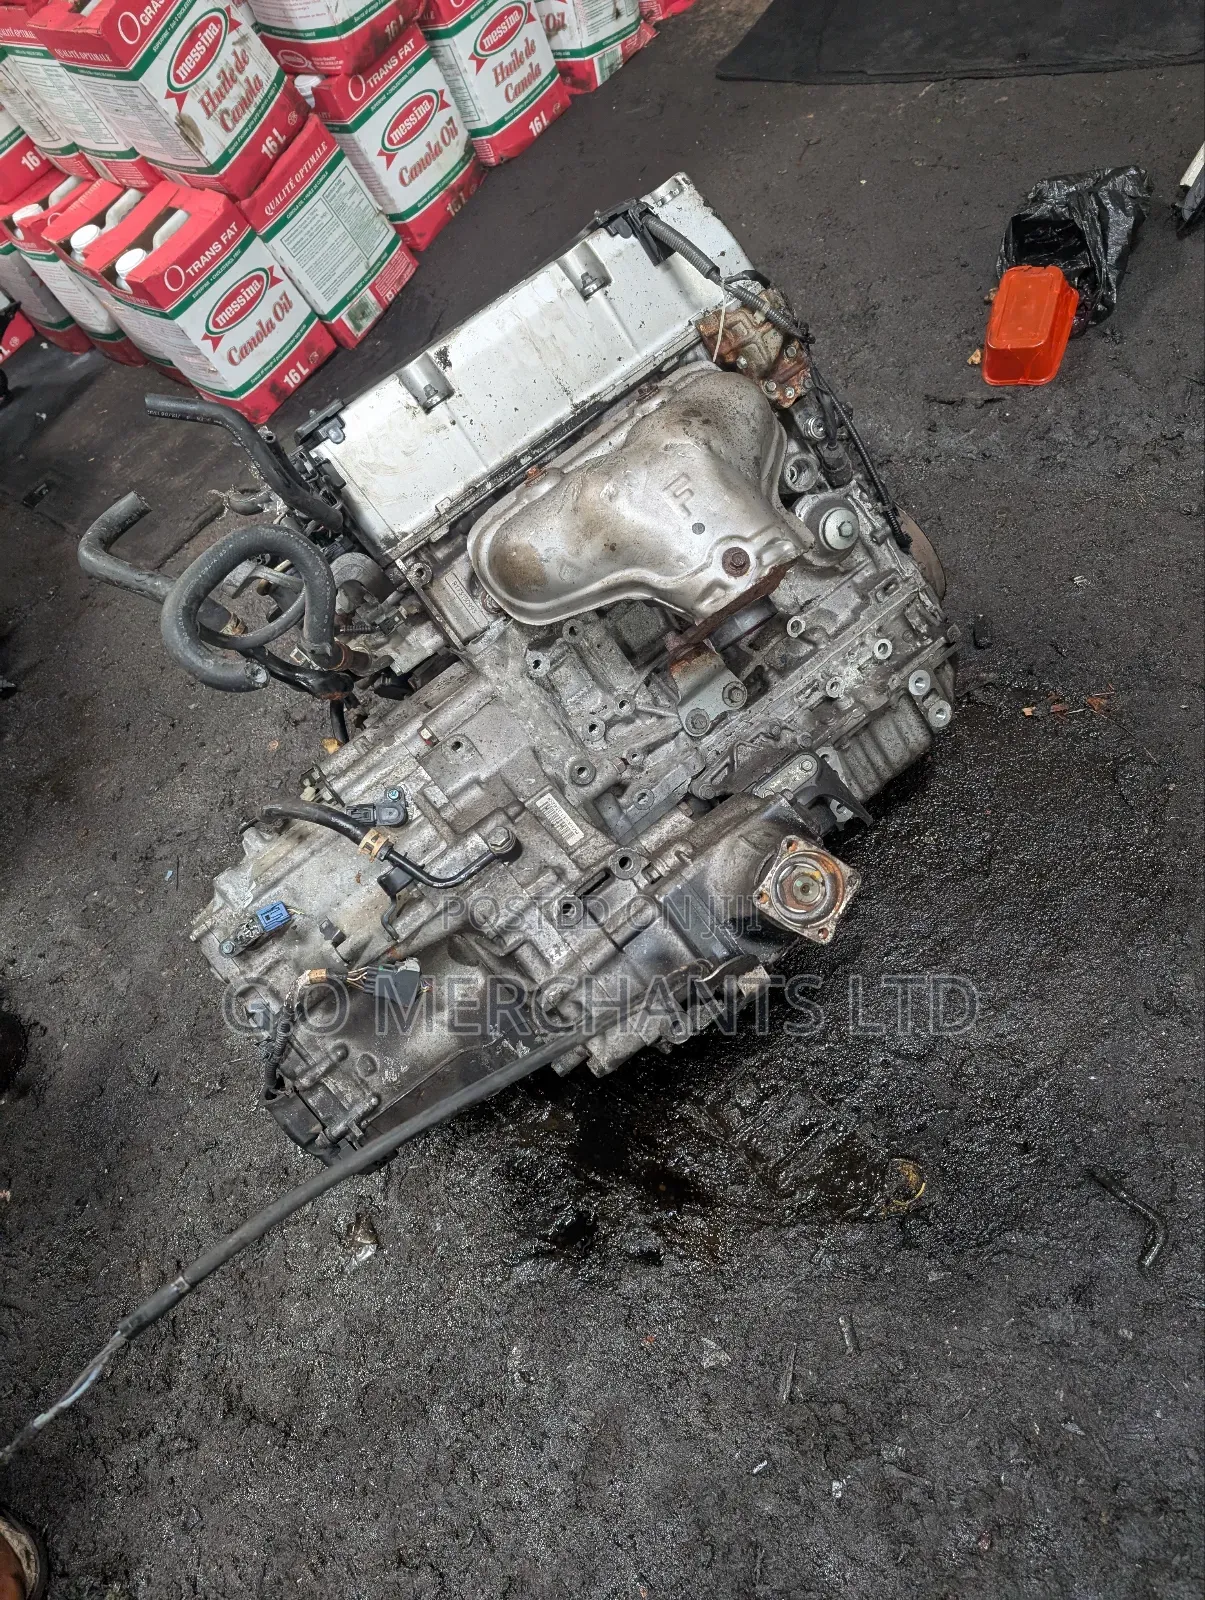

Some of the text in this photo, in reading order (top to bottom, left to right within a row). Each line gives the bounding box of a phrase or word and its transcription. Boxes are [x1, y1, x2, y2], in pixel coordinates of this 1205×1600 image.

[482, 10, 520, 49] messina
[545, 12, 566, 33] Oil
[176, 22, 219, 81] messina
[366, 55, 399, 89] TRANS
[397, 38, 416, 60] FAT
[492, 36, 537, 87] Huile de
[198, 48, 250, 120] Huile de
[219, 73, 264, 133] Canola
[504, 61, 542, 104] Canola
[261, 134, 279, 160] 16
[272, 127, 287, 144] L
[389, 99, 431, 144] messina
[528, 115, 543, 137] 16
[21, 150, 41, 172] 16
[398, 140, 442, 188] Canola
[440, 115, 459, 148] Oil
[264, 177, 296, 216] QUALITÉ
[294, 141, 328, 183] OPTIMALE
[186, 241, 222, 277] TRANS
[220, 222, 239, 245] FAT
[215, 280, 261, 327] messina
[227, 290, 294, 366] Canola Oil
[283, 361, 310, 389] 16 L
